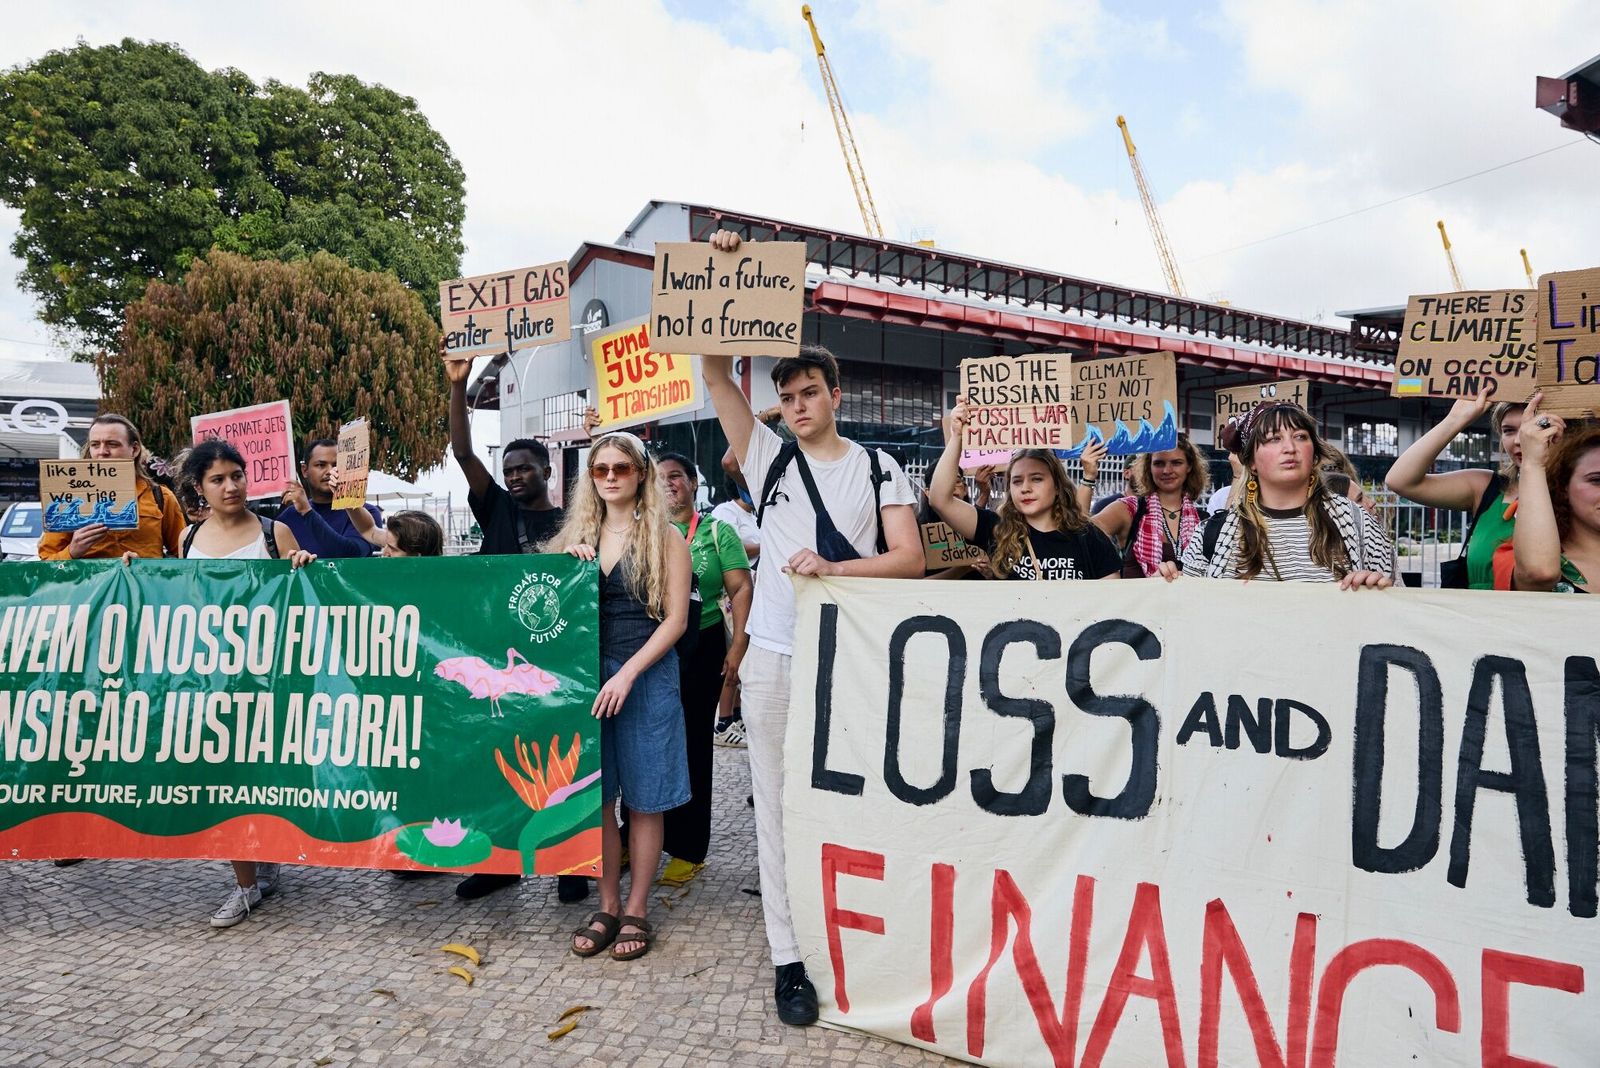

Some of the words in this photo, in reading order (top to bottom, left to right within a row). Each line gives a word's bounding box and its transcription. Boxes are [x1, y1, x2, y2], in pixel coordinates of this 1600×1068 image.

[524, 267, 565, 302] GAS
[661, 253, 669, 290] I
[670, 257, 715, 290] want
[719, 275, 730, 288] a
[736, 257, 796, 291] future,
[1418, 294, 1492, 317] THERE
[446, 314, 493, 349] enter
[505, 307, 554, 355] future
[657, 299, 695, 338] not
[701, 317, 713, 335] a
[719, 299, 797, 340] furnace
[606, 352, 675, 388] JUST
[967, 362, 1011, 385] END
[1015, 359, 1058, 383] THE
[1399, 359, 1432, 377] ON
[967, 384, 1060, 406] RUSSIAN
[1118, 377, 1155, 398] NOT
[1428, 376, 1498, 396] LAND
[967, 407, 1027, 427] FOSSIL
[1032, 403, 1070, 425] WAR
[1086, 399, 1152, 424] LEVELS
[225, 420, 262, 438] PRIVATE
[264, 415, 287, 435] JETS
[967, 427, 1062, 446] MACHINE
[243, 439, 272, 456] YOUR
[46, 464, 77, 478] like
[87, 463, 118, 478] the
[253, 455, 289, 483] DEBT
[49, 491, 73, 503] we
[86, 488, 117, 503] rise
[67, 479, 96, 488] sea
[1038, 557, 1075, 569] MORE
[1048, 569, 1084, 581] FUELS
[508, 572, 539, 610] FRIDAYS
[541, 572, 562, 589] FOR
[98, 603, 128, 674] O
[134, 604, 276, 676] NOSSO
[282, 604, 421, 682] FUTURO,
[529, 618, 569, 644] FUTURE
[810, 603, 1164, 820] LOSS
[1175, 690, 1333, 761] AND
[155, 691, 274, 764] JUSTA
[280, 692, 424, 770] AGORA!
[51, 784, 143, 808] FUTURE,
[147, 785, 202, 805] JUST
[206, 785, 330, 809] TRANSITION
[333, 790, 398, 811] NOW!
[820, 842, 1585, 1068] FINANCE
